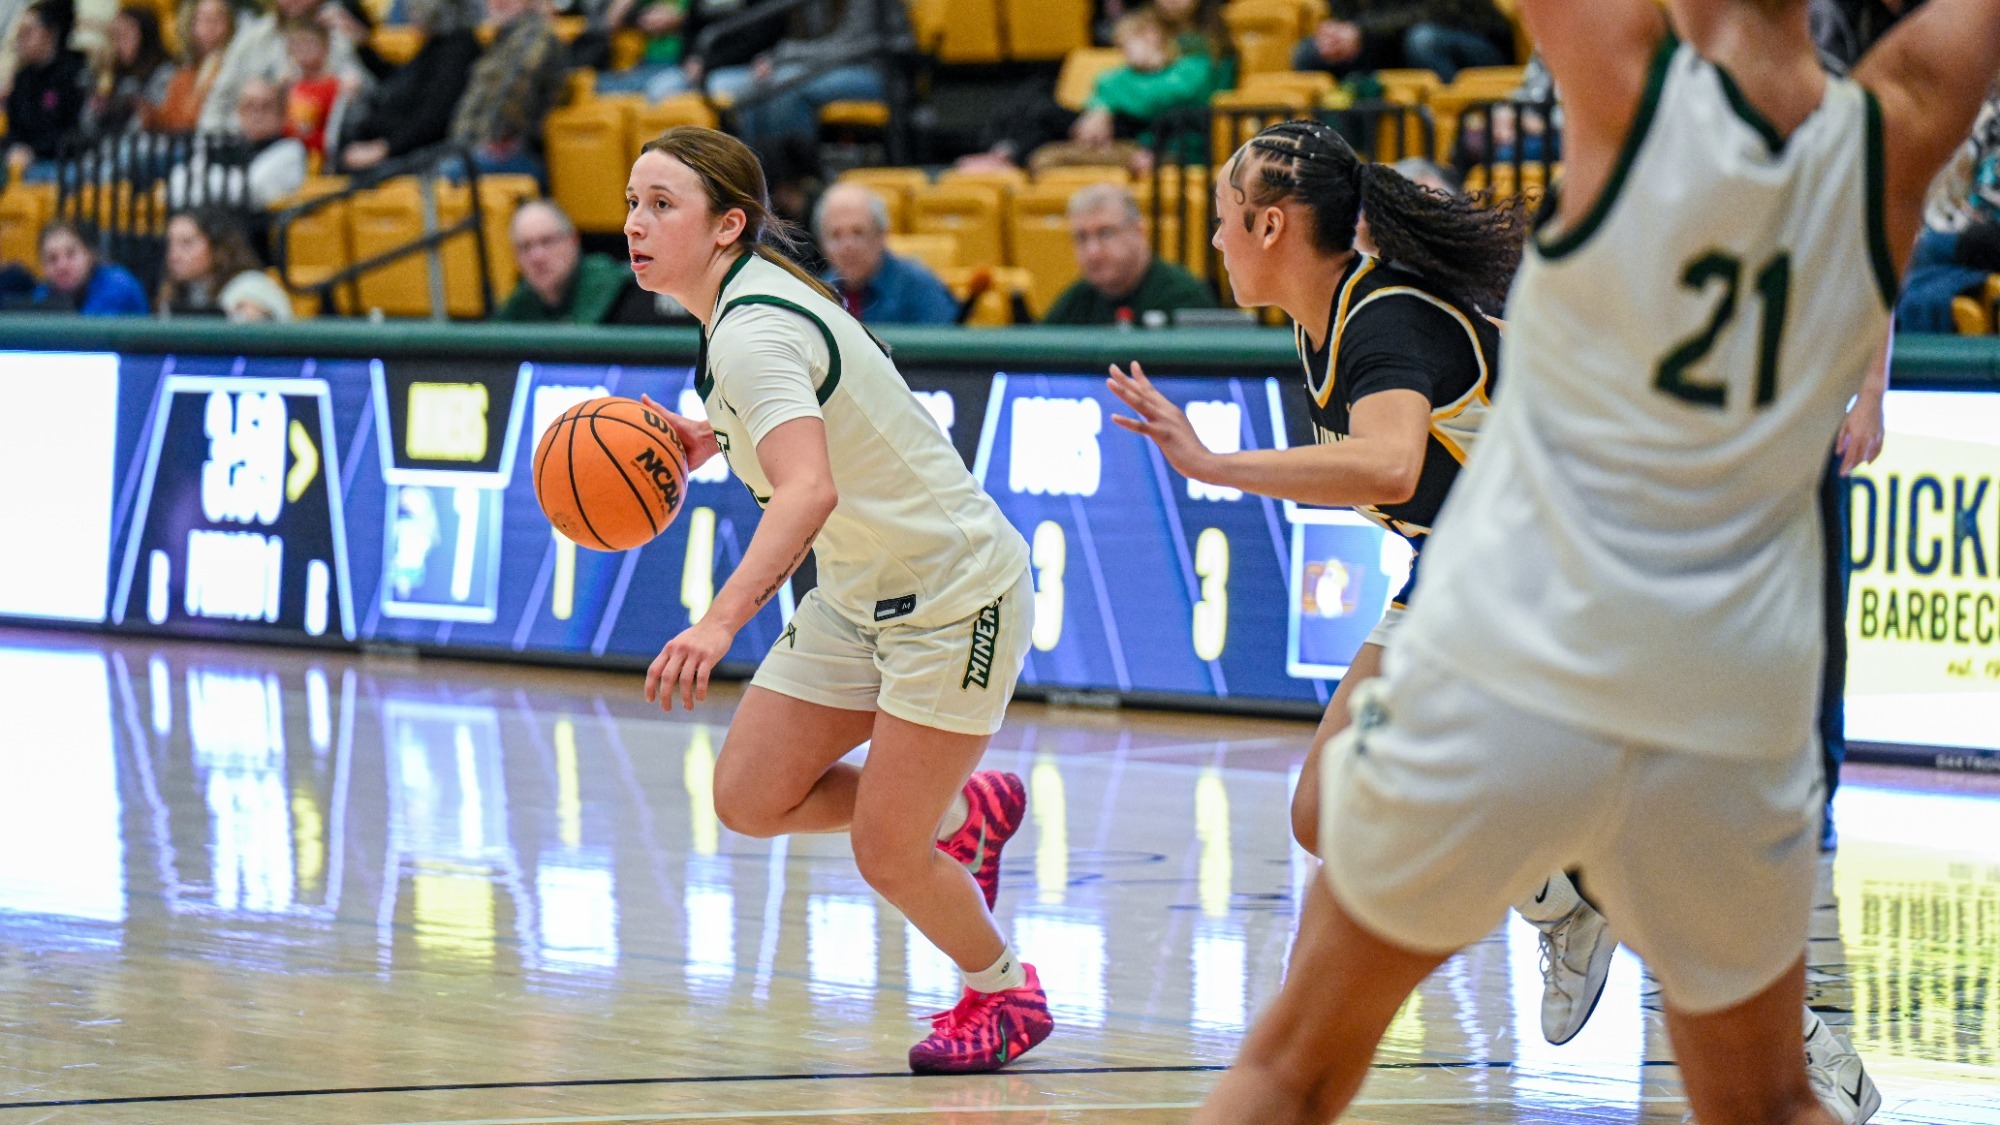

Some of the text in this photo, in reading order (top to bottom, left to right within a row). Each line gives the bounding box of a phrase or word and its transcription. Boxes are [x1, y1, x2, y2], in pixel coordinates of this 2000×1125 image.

[1654, 250, 1789, 408] 21
[635, 447, 680, 514] NCAA
[1850, 474, 2000, 578] DICK
[901, 602, 911, 610] M
[1192, 527, 1229, 662] 3
[1860, 588, 2000, 645] BARBEC
[962, 596, 1002, 690] MINER
